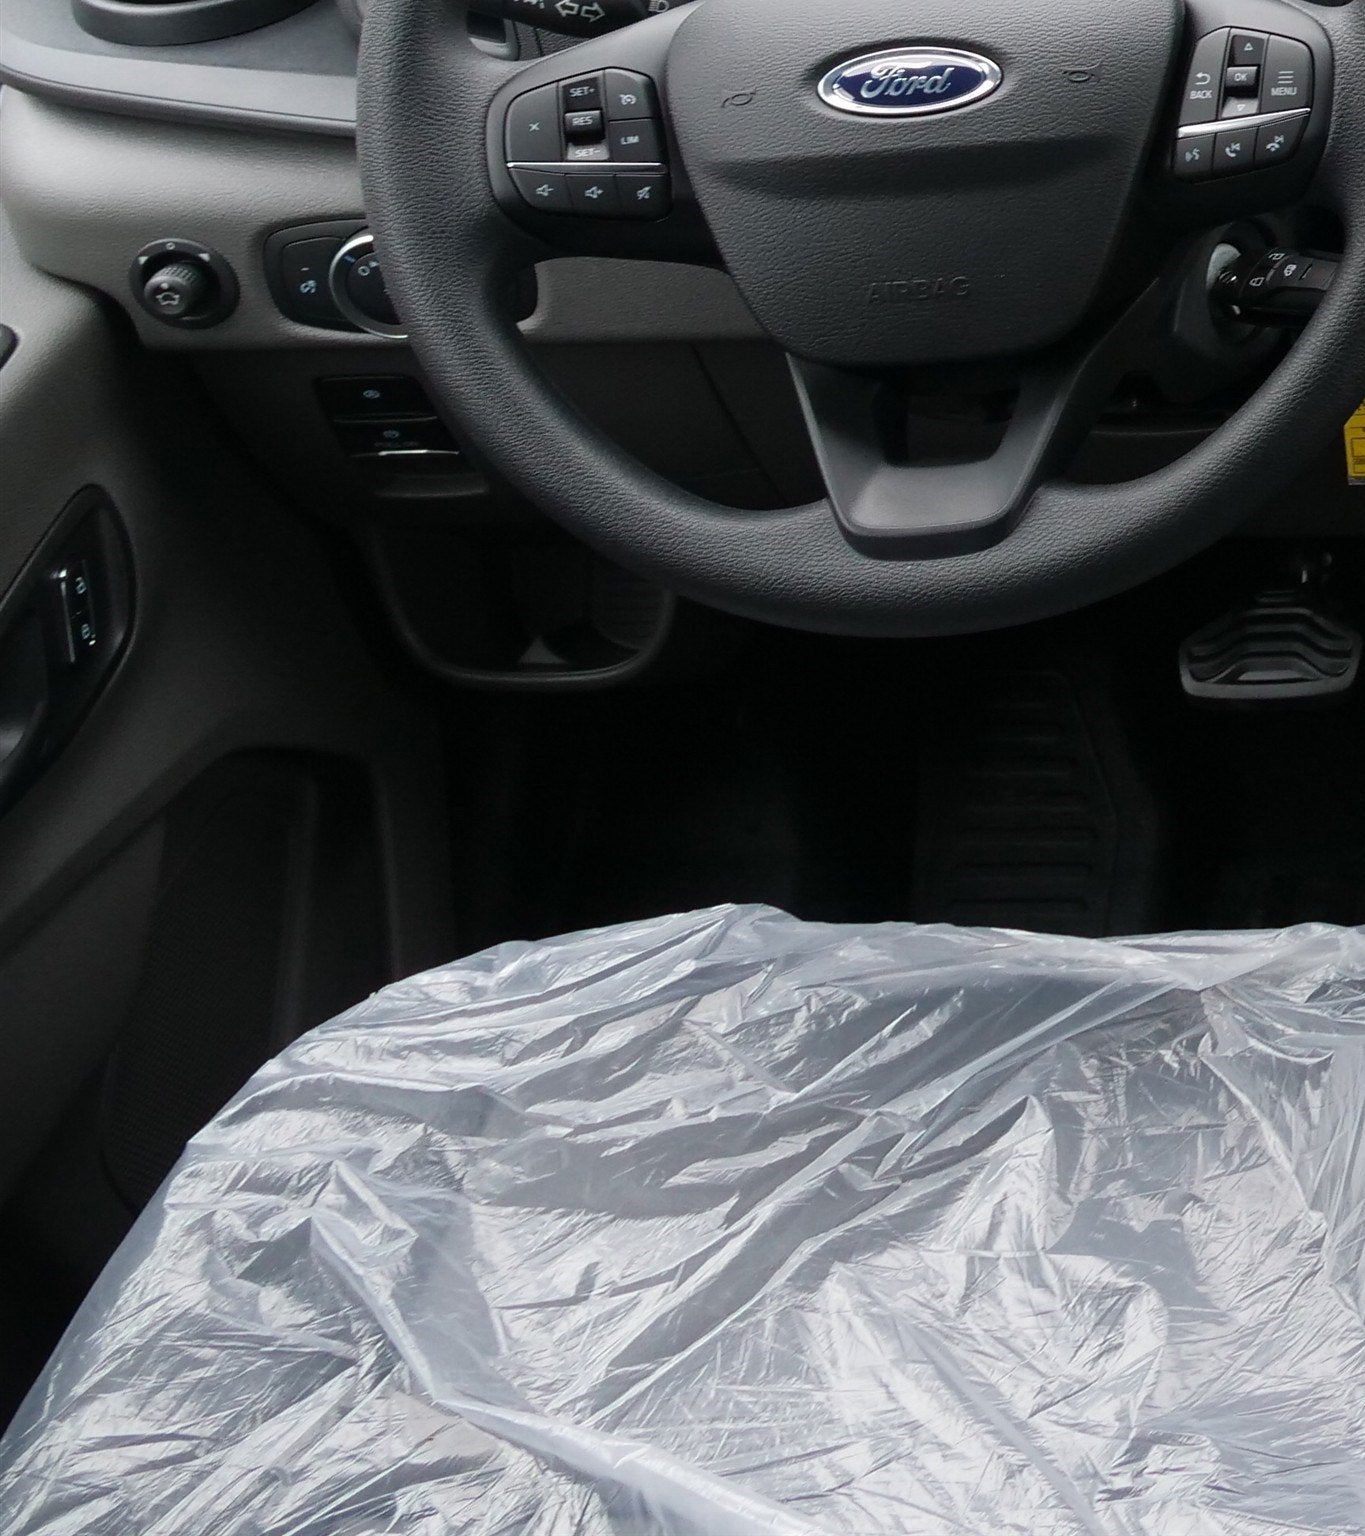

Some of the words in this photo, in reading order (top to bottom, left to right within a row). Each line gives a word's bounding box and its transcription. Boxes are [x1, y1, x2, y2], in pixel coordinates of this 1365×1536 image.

[860, 60, 955, 99] Ford
[1234, 72, 1249, 82] OK
[569, 86, 596, 98] SET+
[1189, 90, 1213, 100] BACK
[1270, 86, 1298, 97] MENU
[572, 116, 593, 126] RES
[620, 135, 640, 145] LIM
[865, 275, 971, 304] AIRBAG
